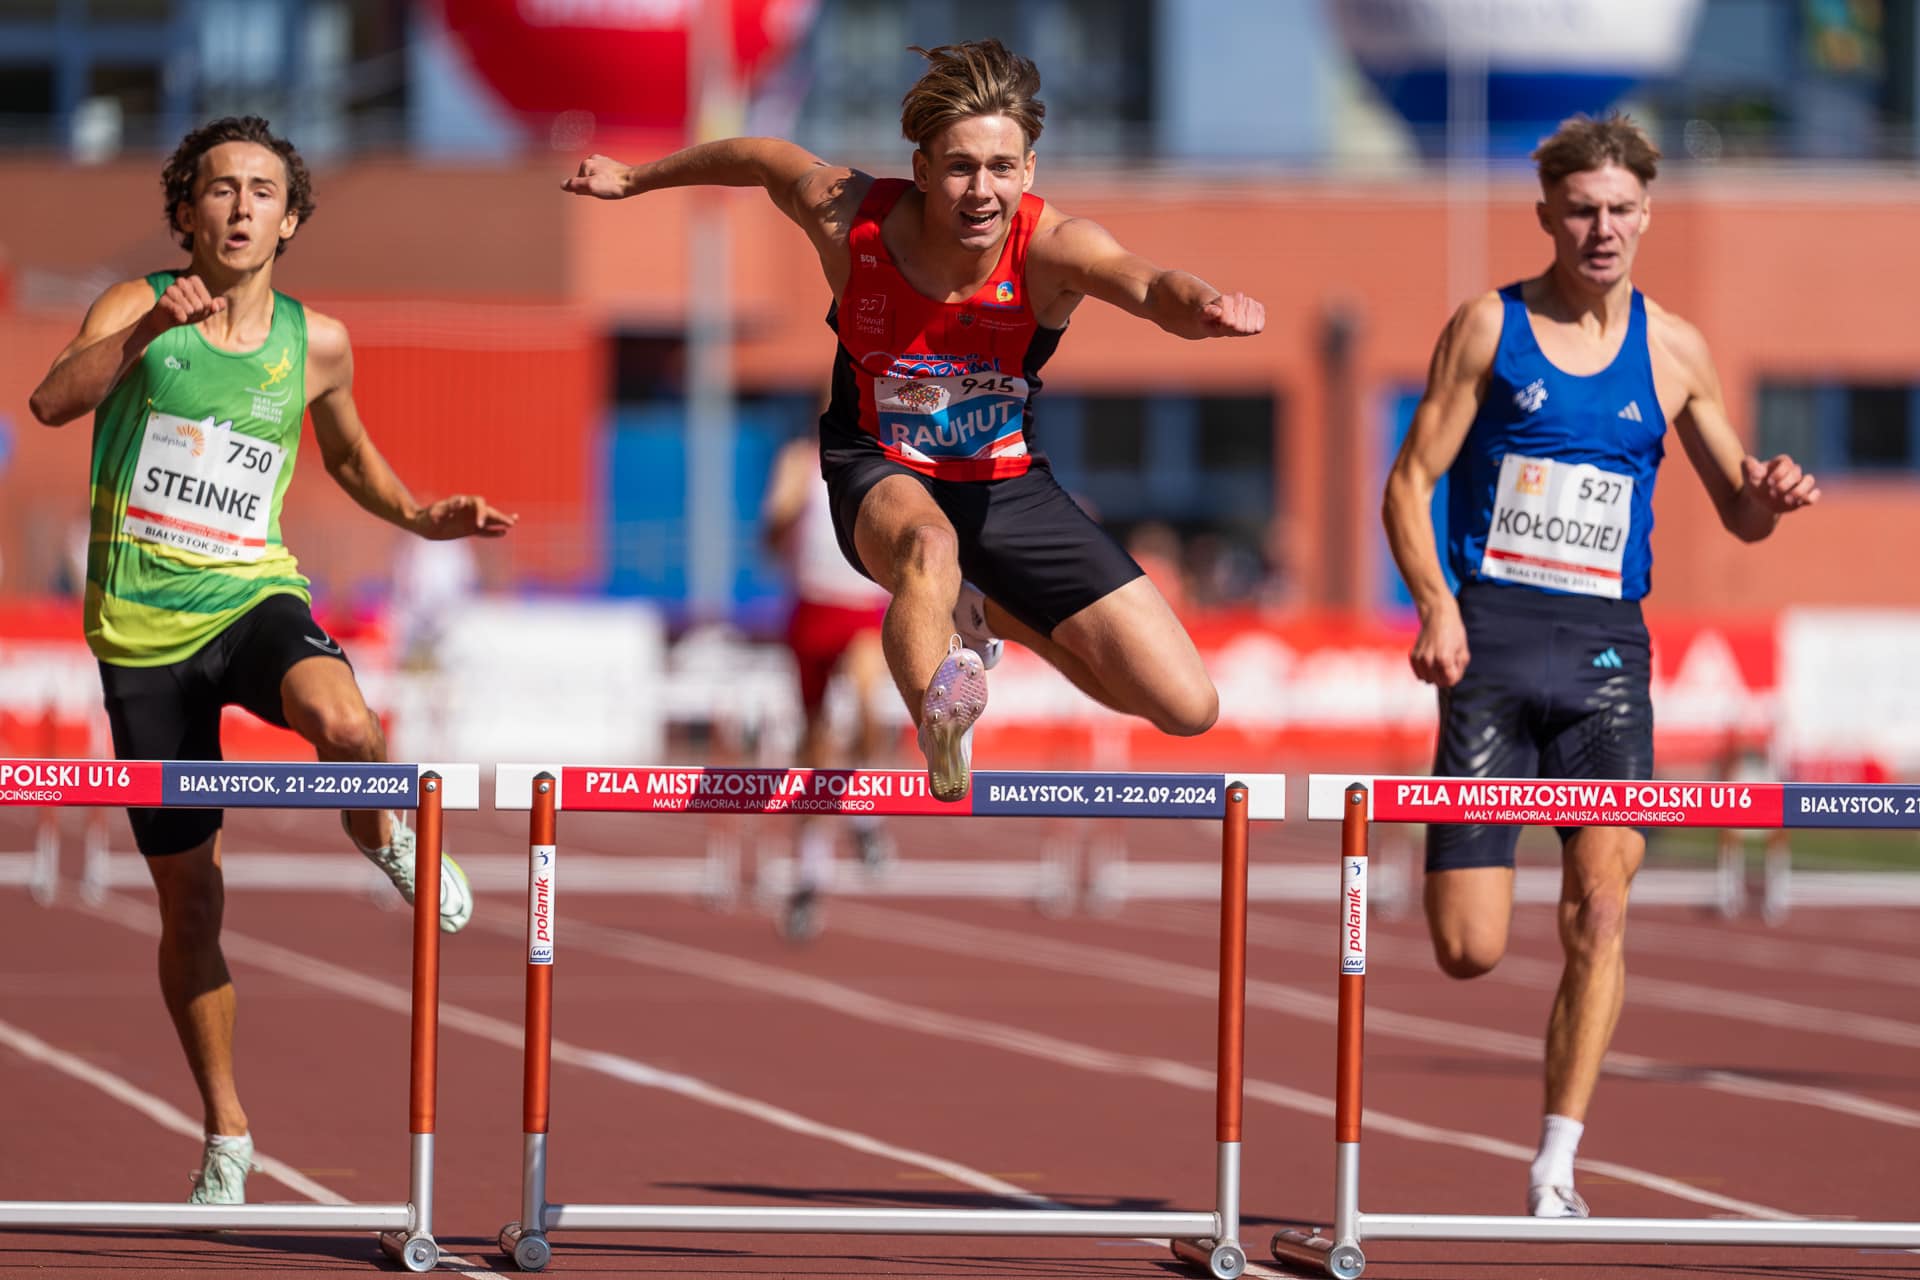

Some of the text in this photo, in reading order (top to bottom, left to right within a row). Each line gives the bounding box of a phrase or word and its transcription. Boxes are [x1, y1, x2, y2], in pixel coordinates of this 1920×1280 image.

[961, 377, 1014, 394] 945
[890, 401, 1015, 447] RAUHUT
[226, 440, 272, 473] 750
[143, 467, 260, 521] STEINKE
[1578, 477, 1622, 505] 527
[1496, 507, 1622, 553] KOŁODZIEJ
[0, 765, 130, 787] POLSKI U16
[179, 775, 409, 795] BIAŁYSTOK, 21-22.09.2024
[586, 772, 934, 798] PZLA MISTRZOSTWA POLSKI U1
[652, 799, 875, 811] MAŁY MEMORIAŁ JANUSZA KUSOCIŃSKIEGO
[989, 785, 1217, 804] BIAŁYSTOK, 21-22.09.2024
[1397, 785, 1752, 808] PZLA MISTRZOSTWA POLSKI U16
[1800, 796, 1899, 815] BIAŁYSTOK,
[1464, 809, 1685, 822] MAŁY MEMORIAŁ JANUSZA KUSOCIŃSKIEGO
[534, 877, 550, 942] polanik
[1346, 887, 1362, 952] polanik
